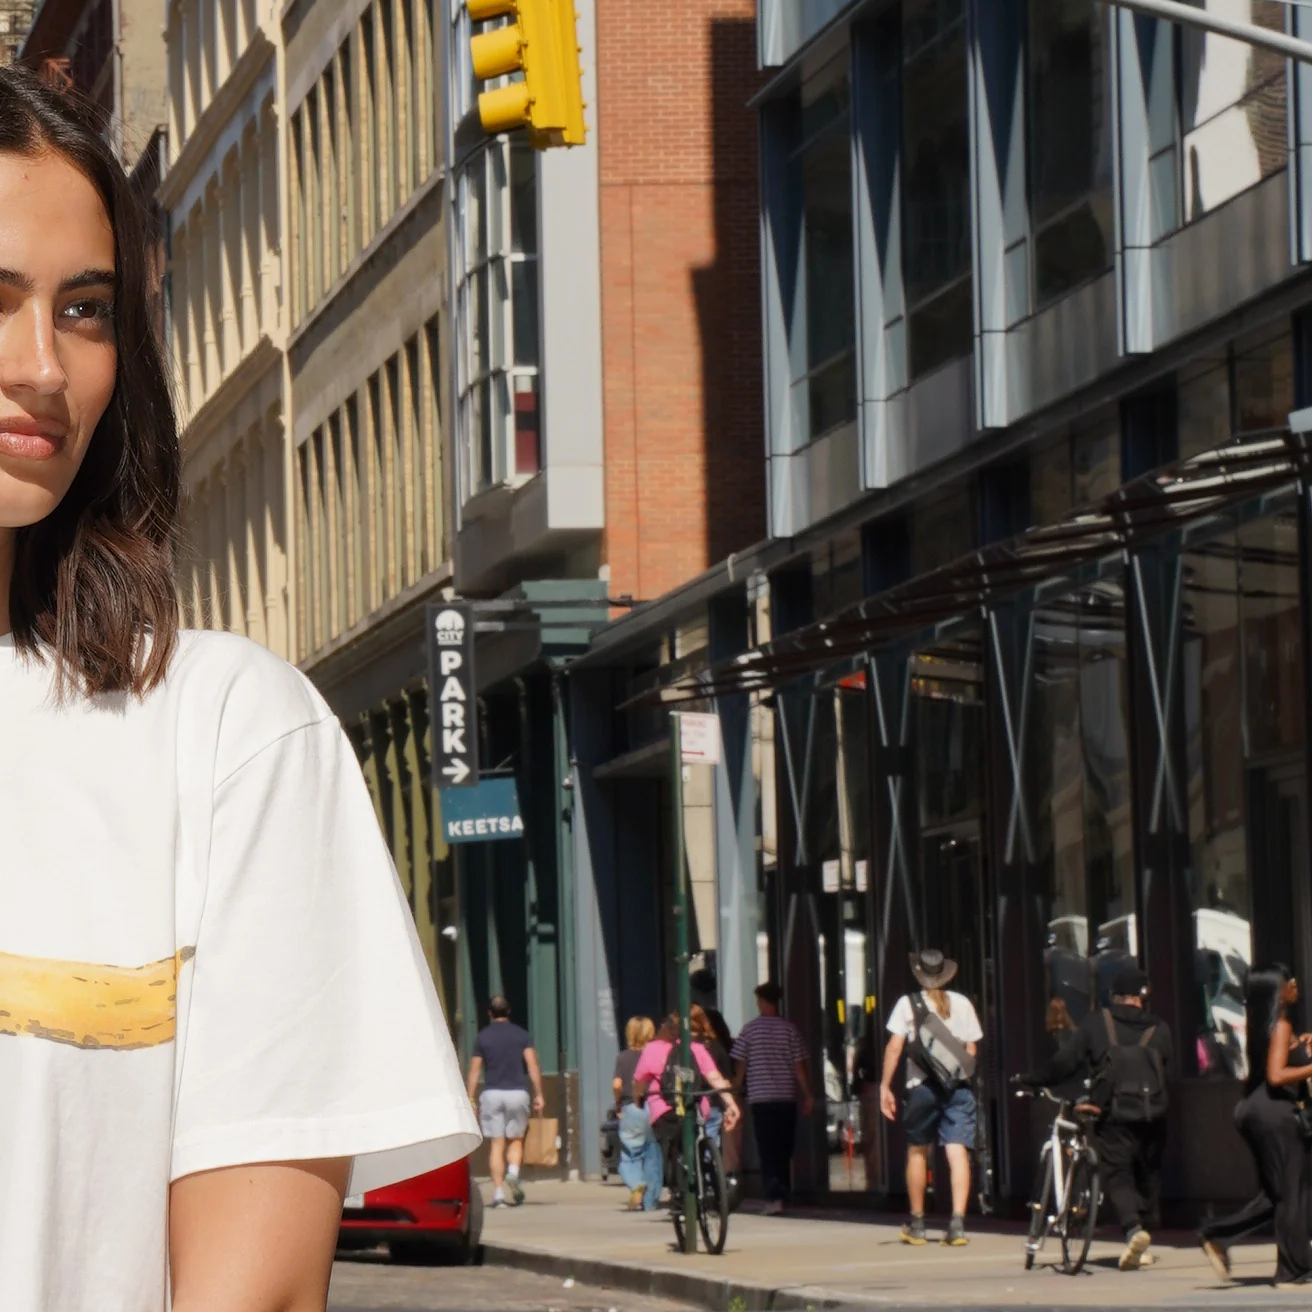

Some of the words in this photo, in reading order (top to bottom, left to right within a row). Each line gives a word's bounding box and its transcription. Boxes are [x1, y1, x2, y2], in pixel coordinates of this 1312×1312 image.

[437, 630, 464, 641] CITY
[440, 650, 467, 754] PARK
[448, 815, 524, 837] KEETSA
